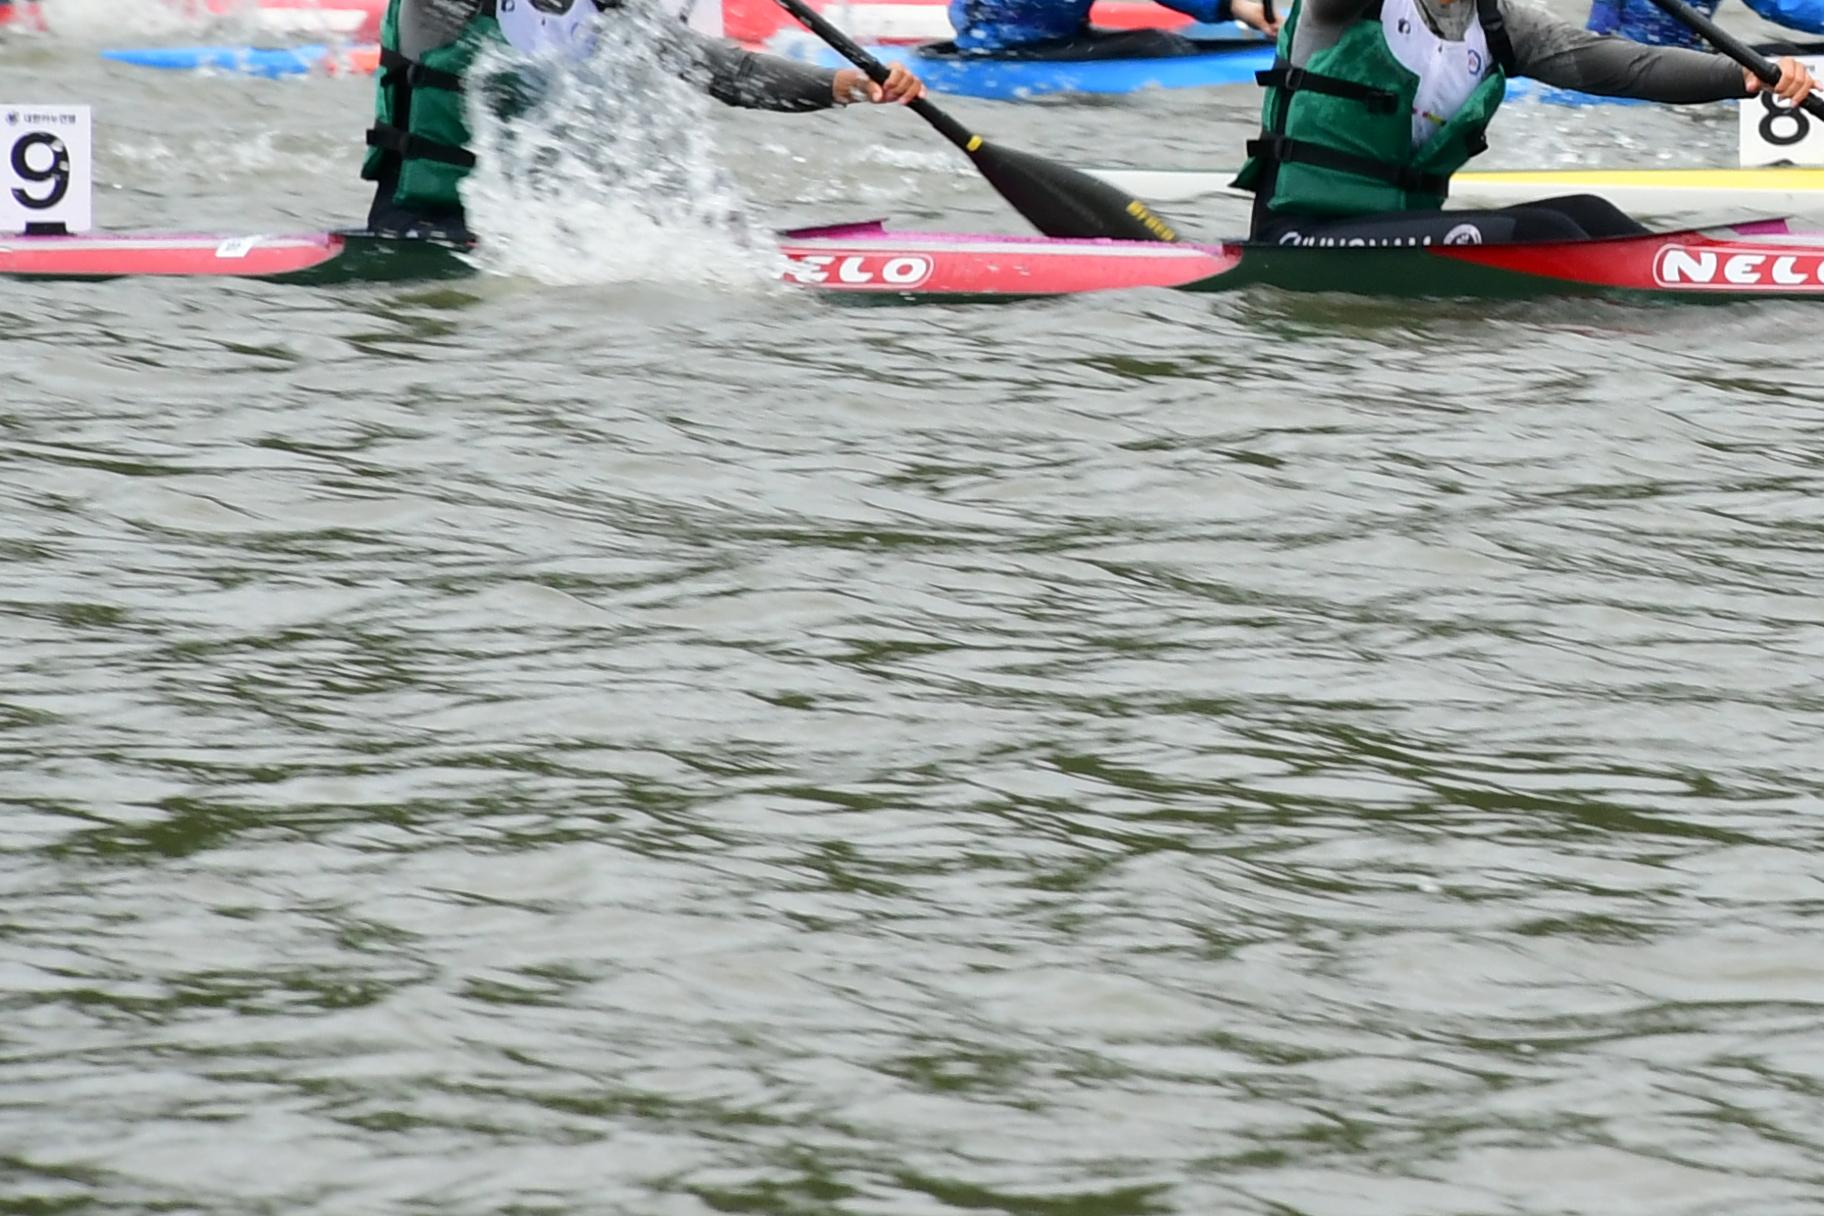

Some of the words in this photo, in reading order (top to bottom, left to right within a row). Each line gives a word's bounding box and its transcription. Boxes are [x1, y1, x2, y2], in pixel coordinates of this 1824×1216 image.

[1758, 88, 1810, 146] 8
[10, 131, 70, 210] 9
[774, 254, 928, 284] ELO
